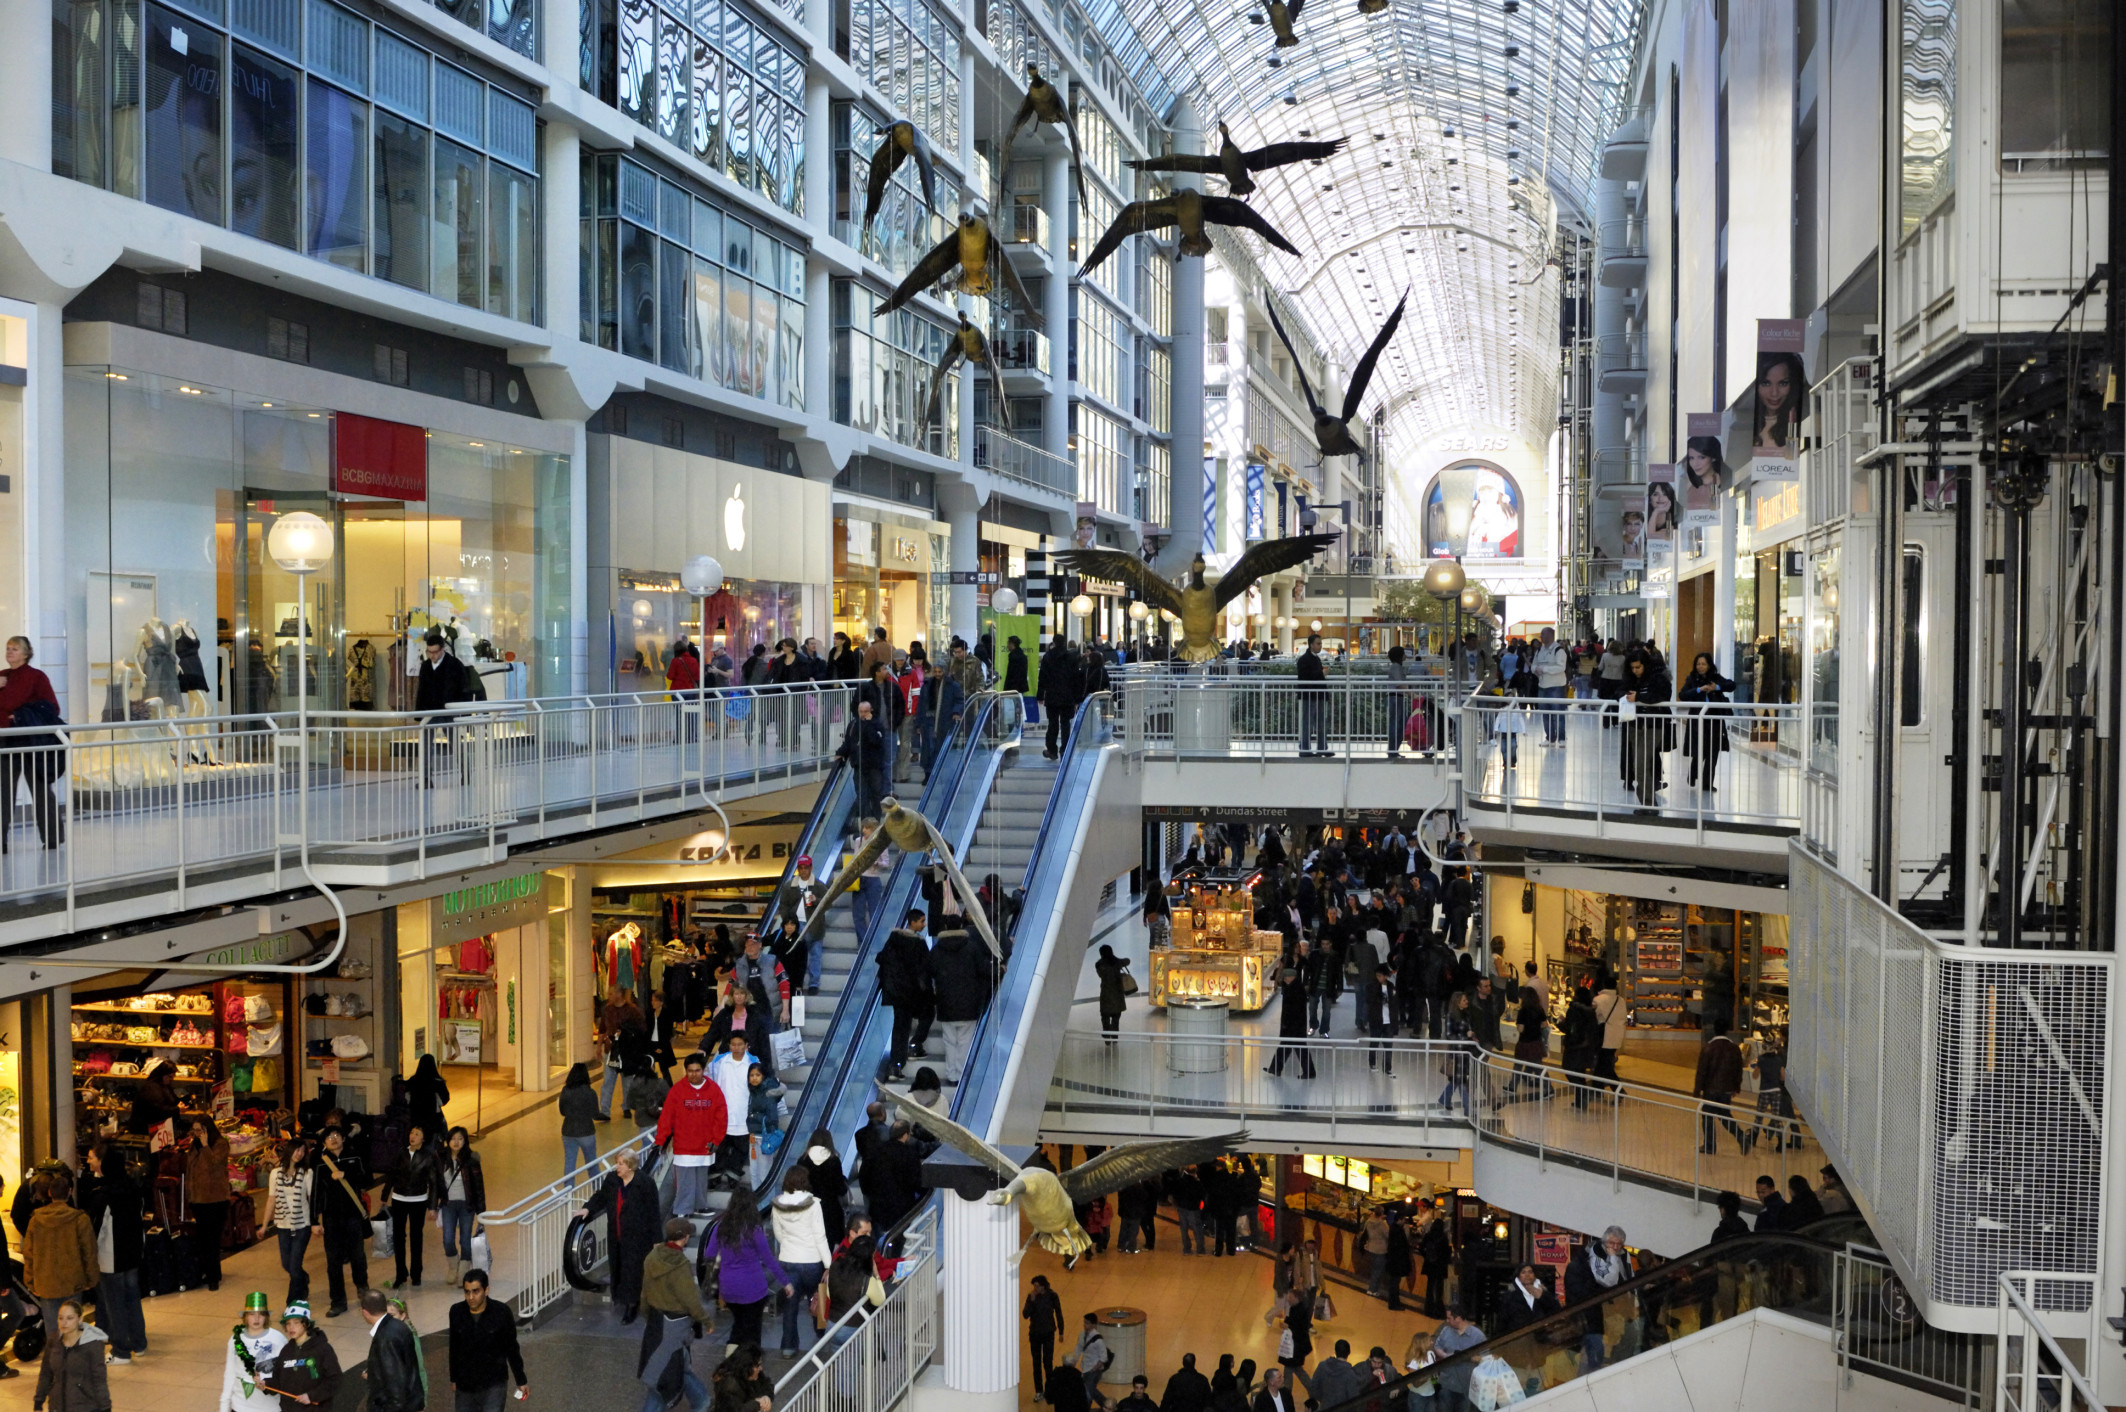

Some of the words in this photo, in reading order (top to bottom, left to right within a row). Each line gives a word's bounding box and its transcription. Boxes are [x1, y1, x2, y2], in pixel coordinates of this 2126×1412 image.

[1440, 437, 1509, 452] SEARS
[1216, 806, 1255, 816] Dundas
[1257, 807, 1288, 817] Street
[443, 872, 542, 916] MOTHERHOOD
[586, 1247, 592, 1265] 2
